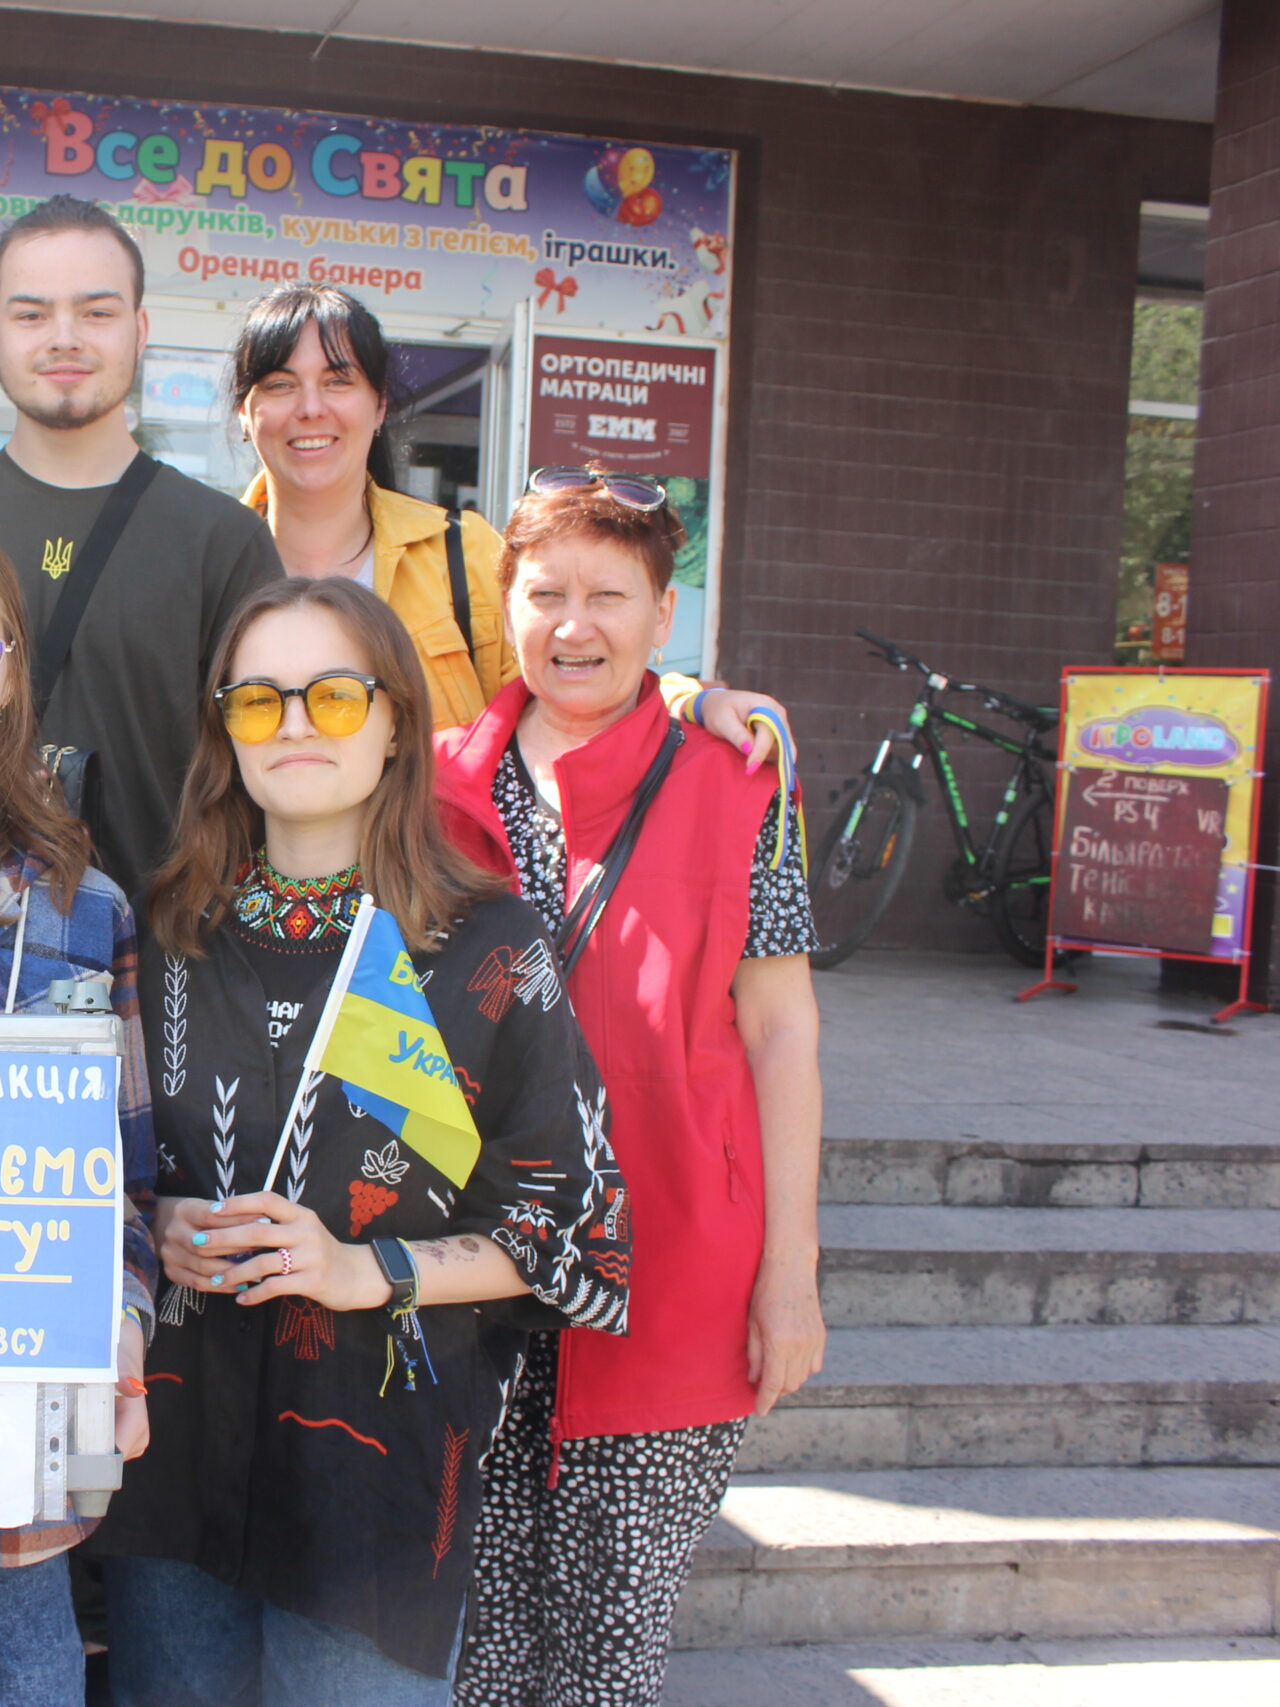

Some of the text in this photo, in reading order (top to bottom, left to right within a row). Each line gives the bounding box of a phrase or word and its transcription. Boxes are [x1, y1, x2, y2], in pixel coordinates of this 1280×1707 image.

[45, 108, 530, 212] Все до Свята
[281, 215, 399, 248] кульки
[404, 224, 422, 248] з
[428, 226, 538, 262] гелієм,
[544, 232, 677, 271] іграшки.
[178, 246, 422, 296] Оренда банера
[540, 352, 707, 386] ОРТОПЕДИЧНІ
[539, 378, 649, 407] МАТРАЦИ
[1095, 769, 1118, 789] 2
